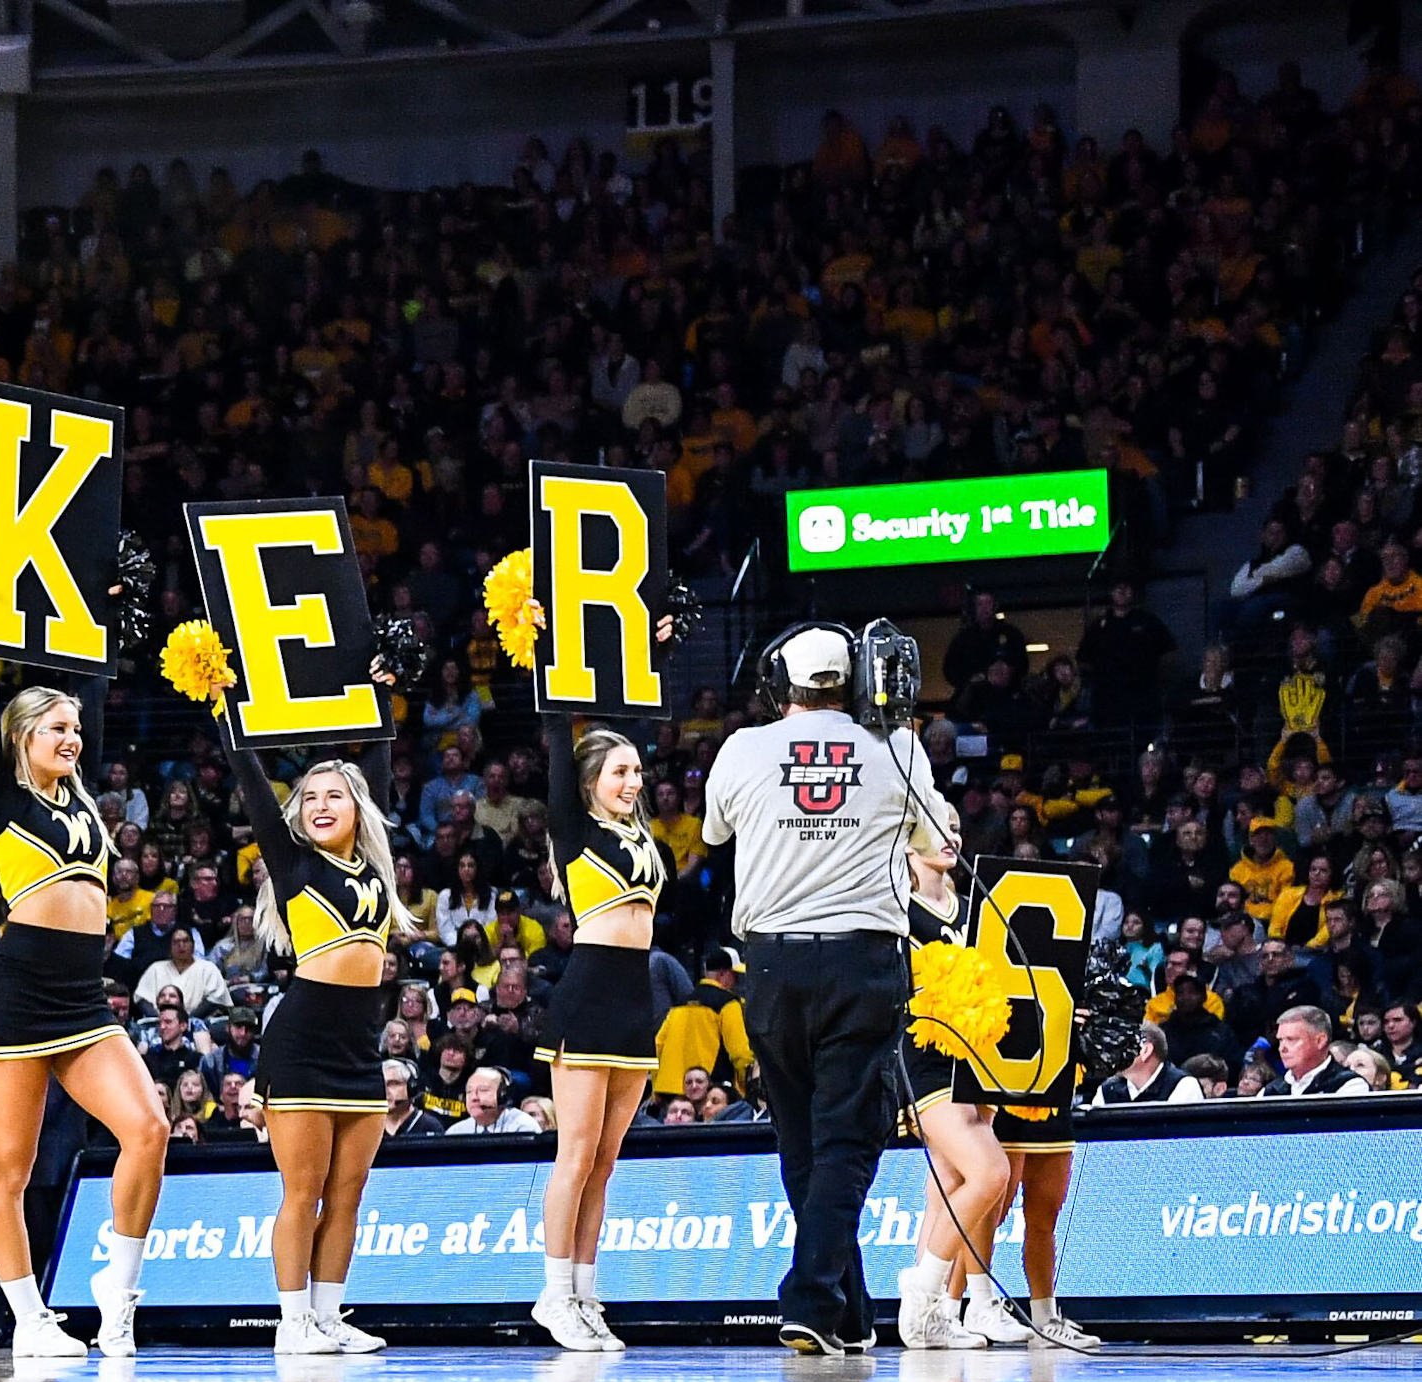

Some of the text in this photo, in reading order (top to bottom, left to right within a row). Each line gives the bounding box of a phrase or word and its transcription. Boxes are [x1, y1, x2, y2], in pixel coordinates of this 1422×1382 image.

[851, 497, 1097, 544] Security 1st Title
[199, 509, 382, 735] E
[540, 474, 663, 708] R
[788, 765, 854, 784] ESPN
[778, 817, 861, 830] PRODUCTION
[799, 830, 837, 841] CREW
[91, 1219, 226, 1262] Sorts
[440, 1213, 491, 1255] at
[723, 1315, 784, 1325] DAKTRONIC
[1328, 1310, 1414, 1321] DAKTRONICS
[230, 1318, 281, 1328] DAKTRONIC
